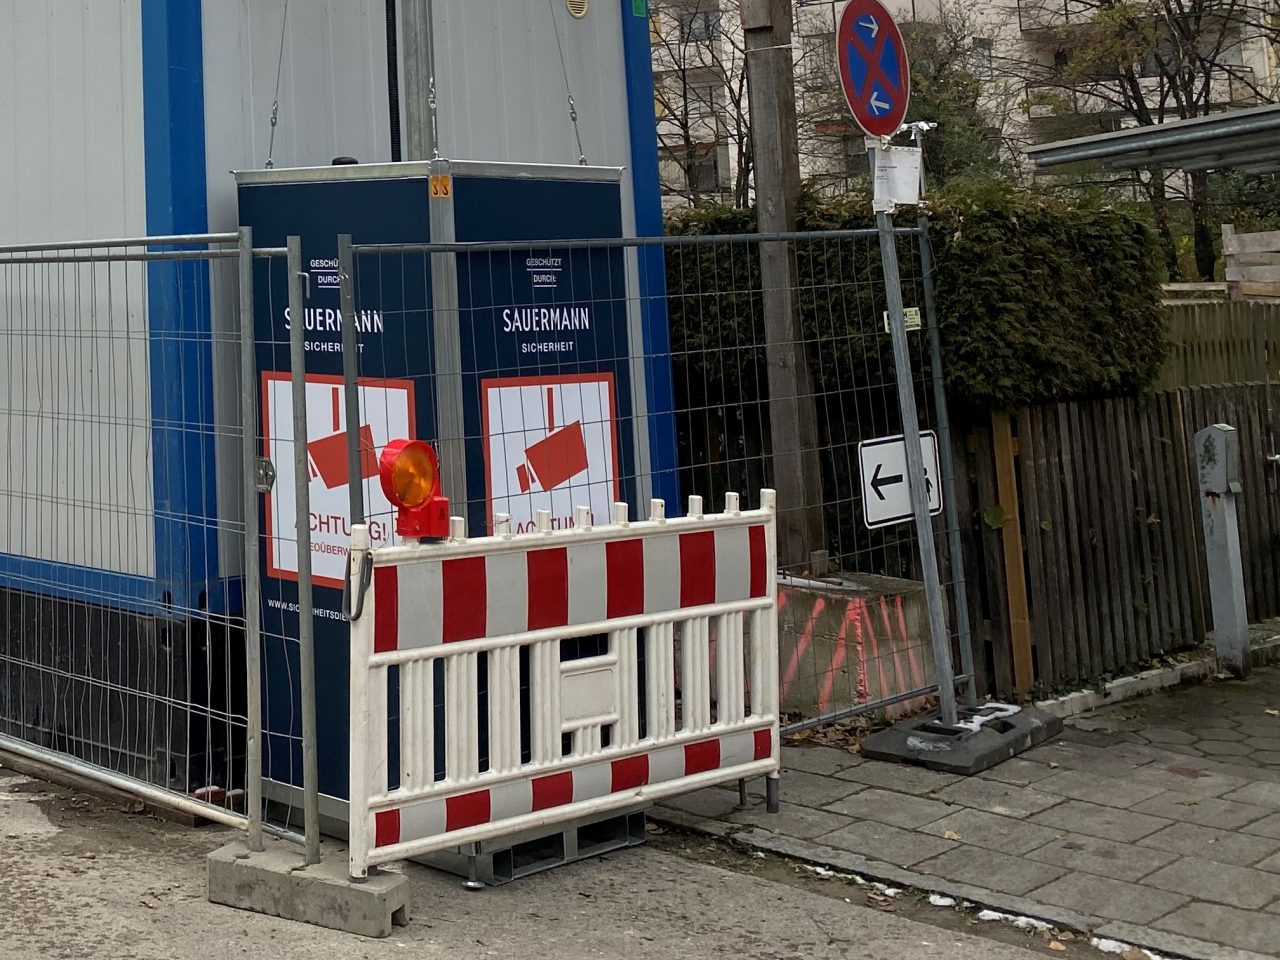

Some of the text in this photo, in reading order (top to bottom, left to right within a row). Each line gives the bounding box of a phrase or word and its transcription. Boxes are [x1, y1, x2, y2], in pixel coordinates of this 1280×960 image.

[310, 258, 340, 268] GESCHÜ
[284, 307, 384, 333] SUERANN
[503, 307, 590, 332] SAUERMANN
[521, 342, 574, 353] SICHERHEIT
[295, 512, 388, 542] CHTUG!
